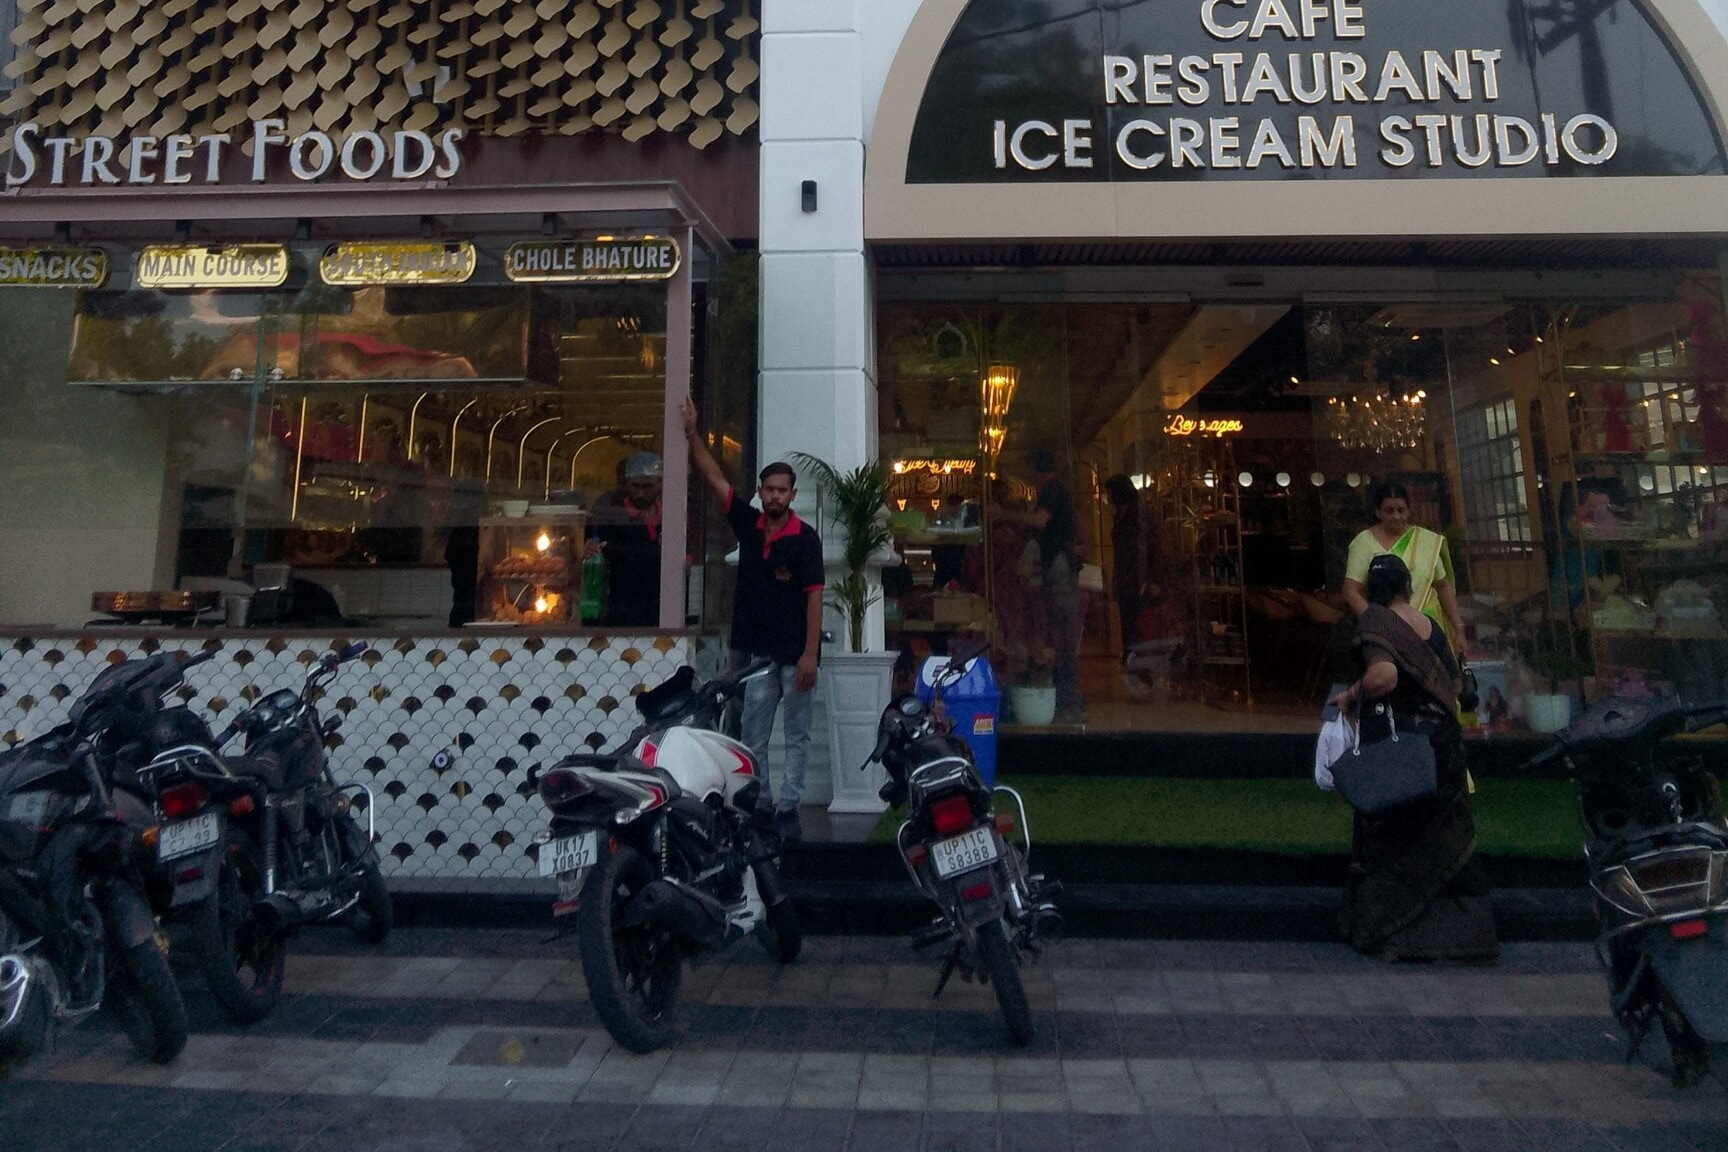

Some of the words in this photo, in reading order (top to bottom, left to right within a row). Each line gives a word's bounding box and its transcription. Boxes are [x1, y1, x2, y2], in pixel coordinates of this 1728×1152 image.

[1103, 49, 1503, 106] RESTAURANT
[993, 118, 1094, 170] ICE
[1115, 115, 1358, 168] CREAM
[1379, 113, 1619, 167] STUDIO
[143, 255, 196, 278] MAIN
[203, 252, 281, 278] COURSE
[513, 247, 577, 272] CHOLE
[582, 245, 671, 270] BHATURE
[556, 834, 585, 855] UK17
[943, 830, 985, 855] UP11C
[552, 849, 589, 873] X0837
[947, 845, 989, 870] S8388
